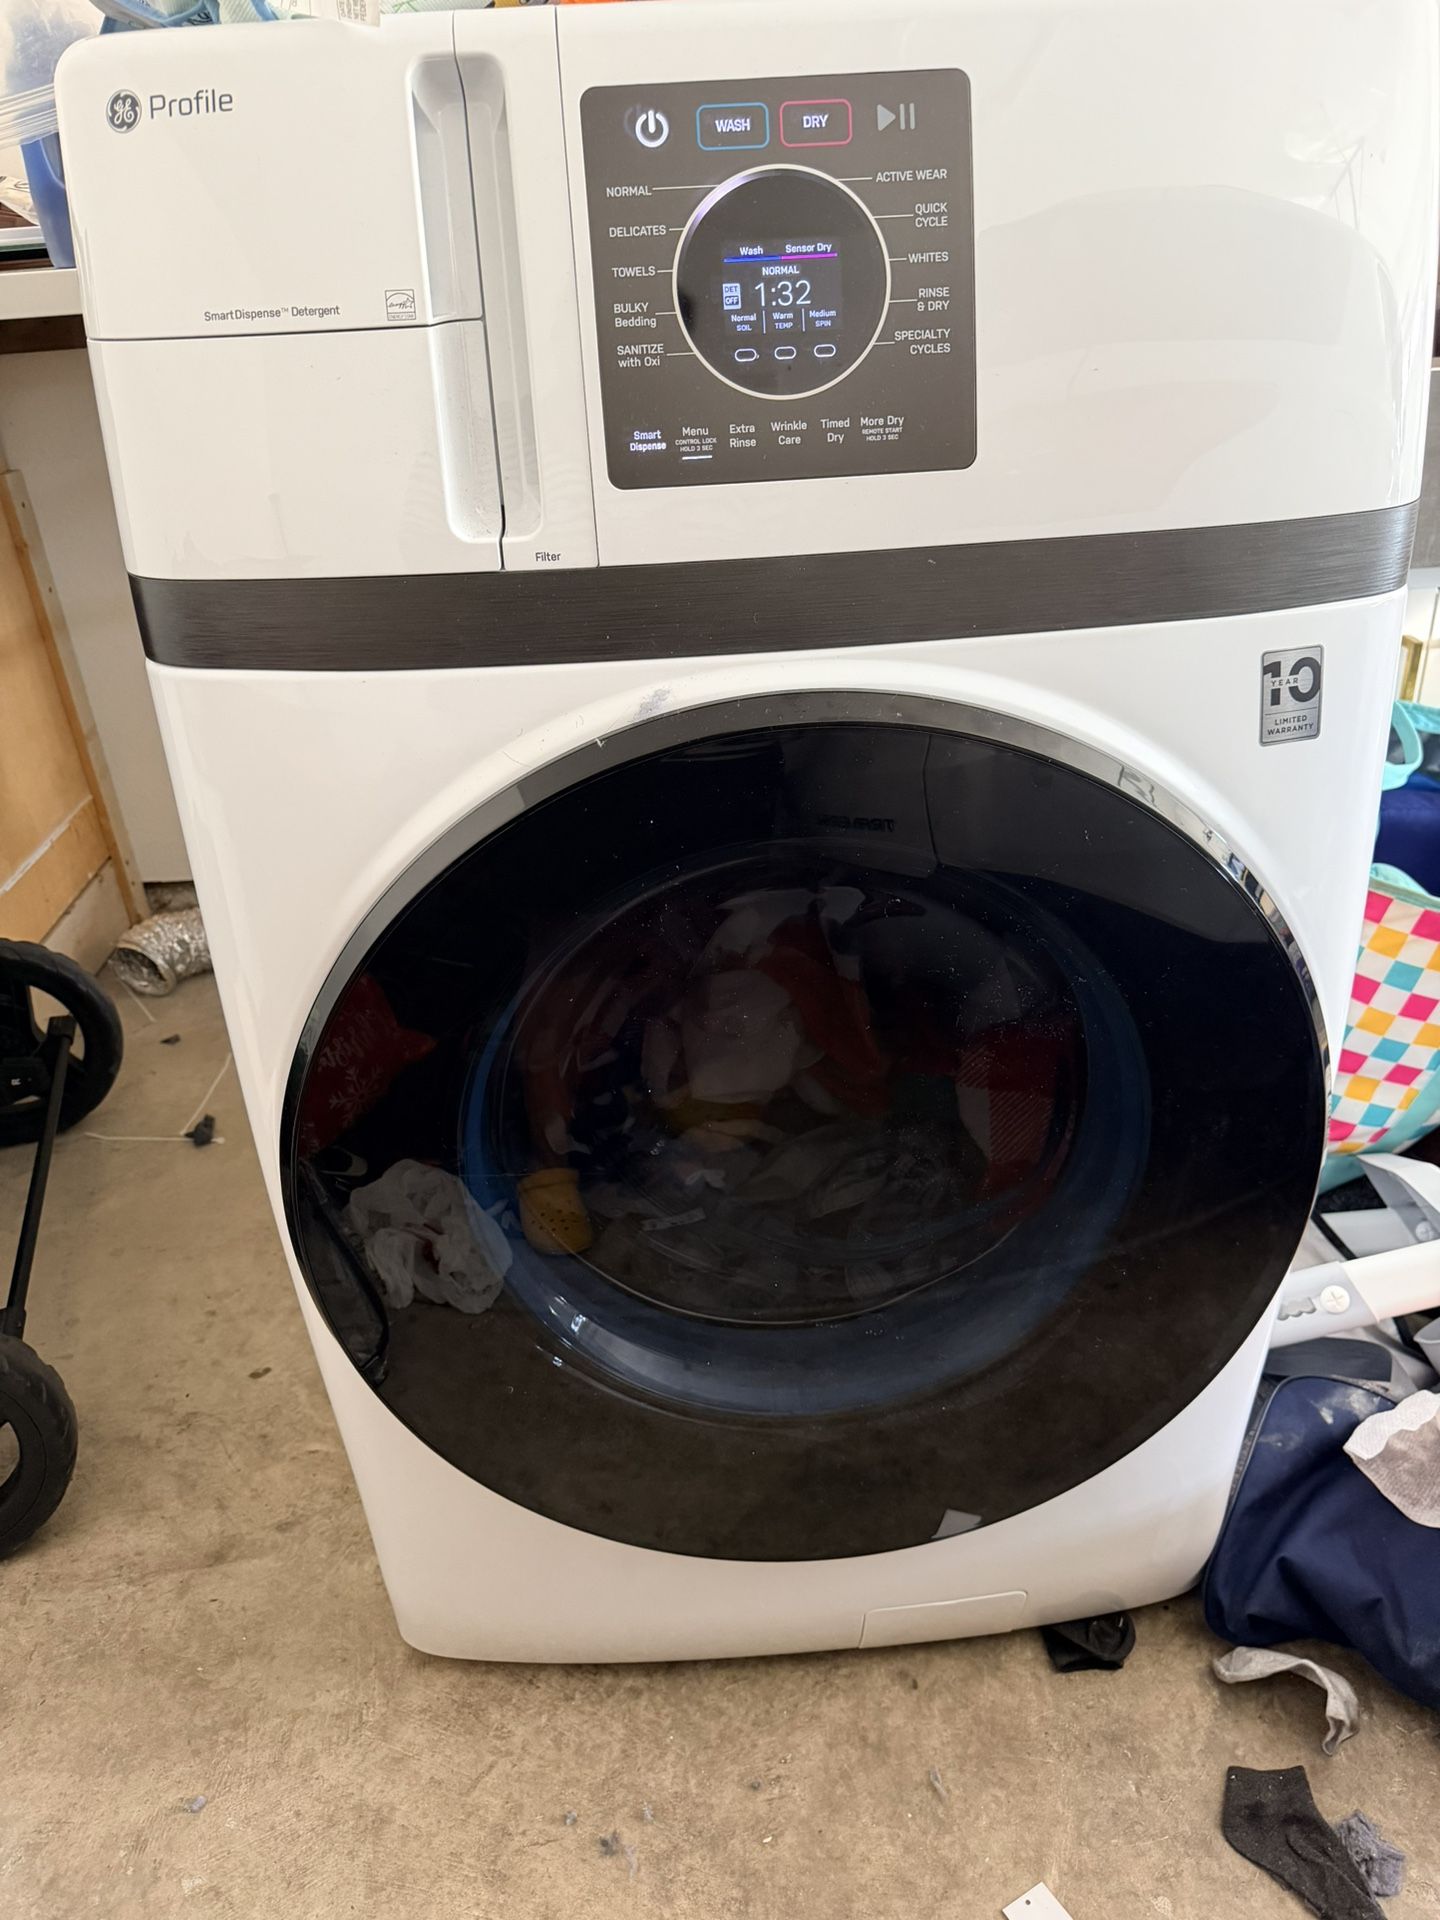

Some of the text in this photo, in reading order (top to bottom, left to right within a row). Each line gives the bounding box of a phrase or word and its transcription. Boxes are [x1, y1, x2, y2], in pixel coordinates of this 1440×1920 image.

[149, 88, 233, 119] Profile
[714, 116, 751, 133] WASH
[802, 113, 829, 129] DRY
[875, 168, 948, 182] ACTIVE WEAR
[606, 185, 652, 198] NORMAL
[914, 202, 948, 216] QUICK
[914, 216, 948, 228] CYCLE
[608, 225, 667, 238] DELICATES
[739, 242, 832, 256] Wash Sensor Dry
[908, 251, 949, 264] WHITES
[612, 265, 656, 278] TOWELS
[761, 264, 800, 277] NORMAL
[754, 279, 812, 307] 1:32
[918, 286, 950, 299] RINSE
[725, 297, 738, 305] OFF
[917, 300, 950, 312] & DRY
[291, 305, 340, 318] Detergent
[613, 302, 649, 314] BULKY
[809, 309, 836, 319] Medium
[731, 313, 757, 323] Normal
[772, 311, 793, 321] Warm
[615, 316, 657, 329] Bedding
[736, 324, 752, 332] SOIL
[774, 322, 794, 330] TEMP
[815, 320, 831, 328] SPIN
[894, 328, 951, 341] SPECIALTY
[616, 343, 665, 356] SANITIZE
[910, 343, 951, 355] CYCLES
[618, 355, 660, 368] with Oxi
[770, 420, 808, 432] Wrinkle
[820, 417, 851, 429] Timed
[860, 415, 905, 427] More Dry
[682, 426, 709, 437] Menu
[729, 423, 756, 434] Extra
[862, 426, 903, 435] REMOTE START
[633, 429, 662, 441] Smart
[778, 435, 802, 446] Care
[827, 432, 844, 444] Dry
[866, 434, 882, 442] HOLD
[888, 433, 899, 441] SEC
[629, 441, 667, 453] Dispense
[675, 437, 718, 447] CONTROL LOCK
[729, 437, 757, 448] Rinse
[680, 445, 696, 453] HOLD
[701, 444, 713, 452] SEC
[535, 551, 562, 562] Filter
[1263, 656, 1321, 706] 10
[1271, 676, 1299, 688] YEAR
[1274, 714, 1308, 726] LIMITED
[1267, 723, 1314, 736] WARRANTY
